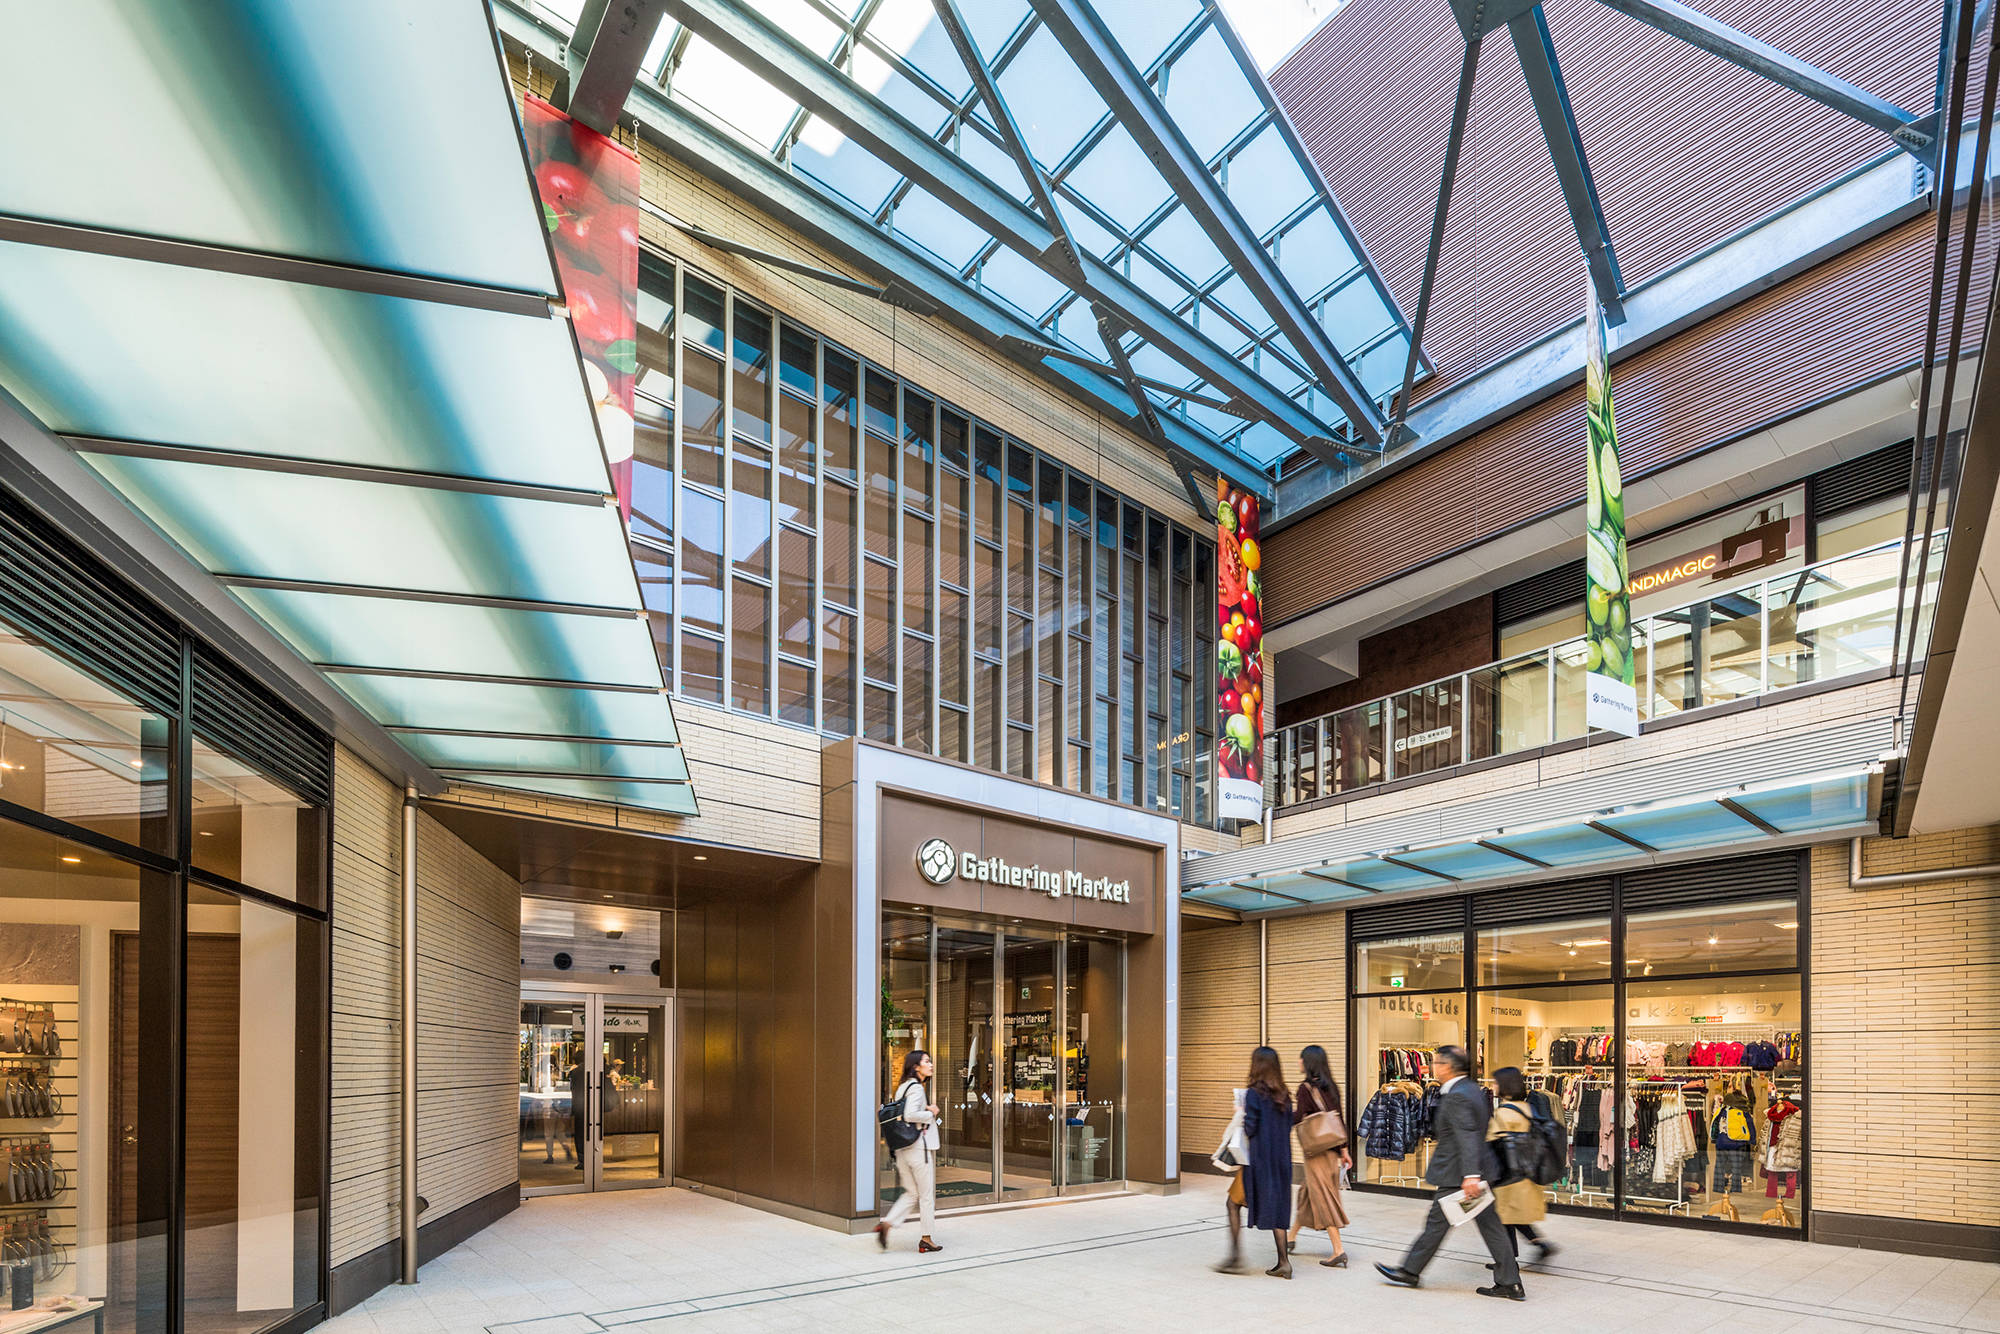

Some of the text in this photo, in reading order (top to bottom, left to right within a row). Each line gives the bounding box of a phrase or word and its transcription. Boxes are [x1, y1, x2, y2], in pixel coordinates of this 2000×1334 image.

[959, 851, 1130, 904] Gathering Market
[1379, 996, 1459, 1015] hakka kids
[1491, 1006, 1522, 1017] FITTING ROOM
[1628, 999, 1784, 1018] akka baby
[1025, 1013, 1047, 1024] Market
